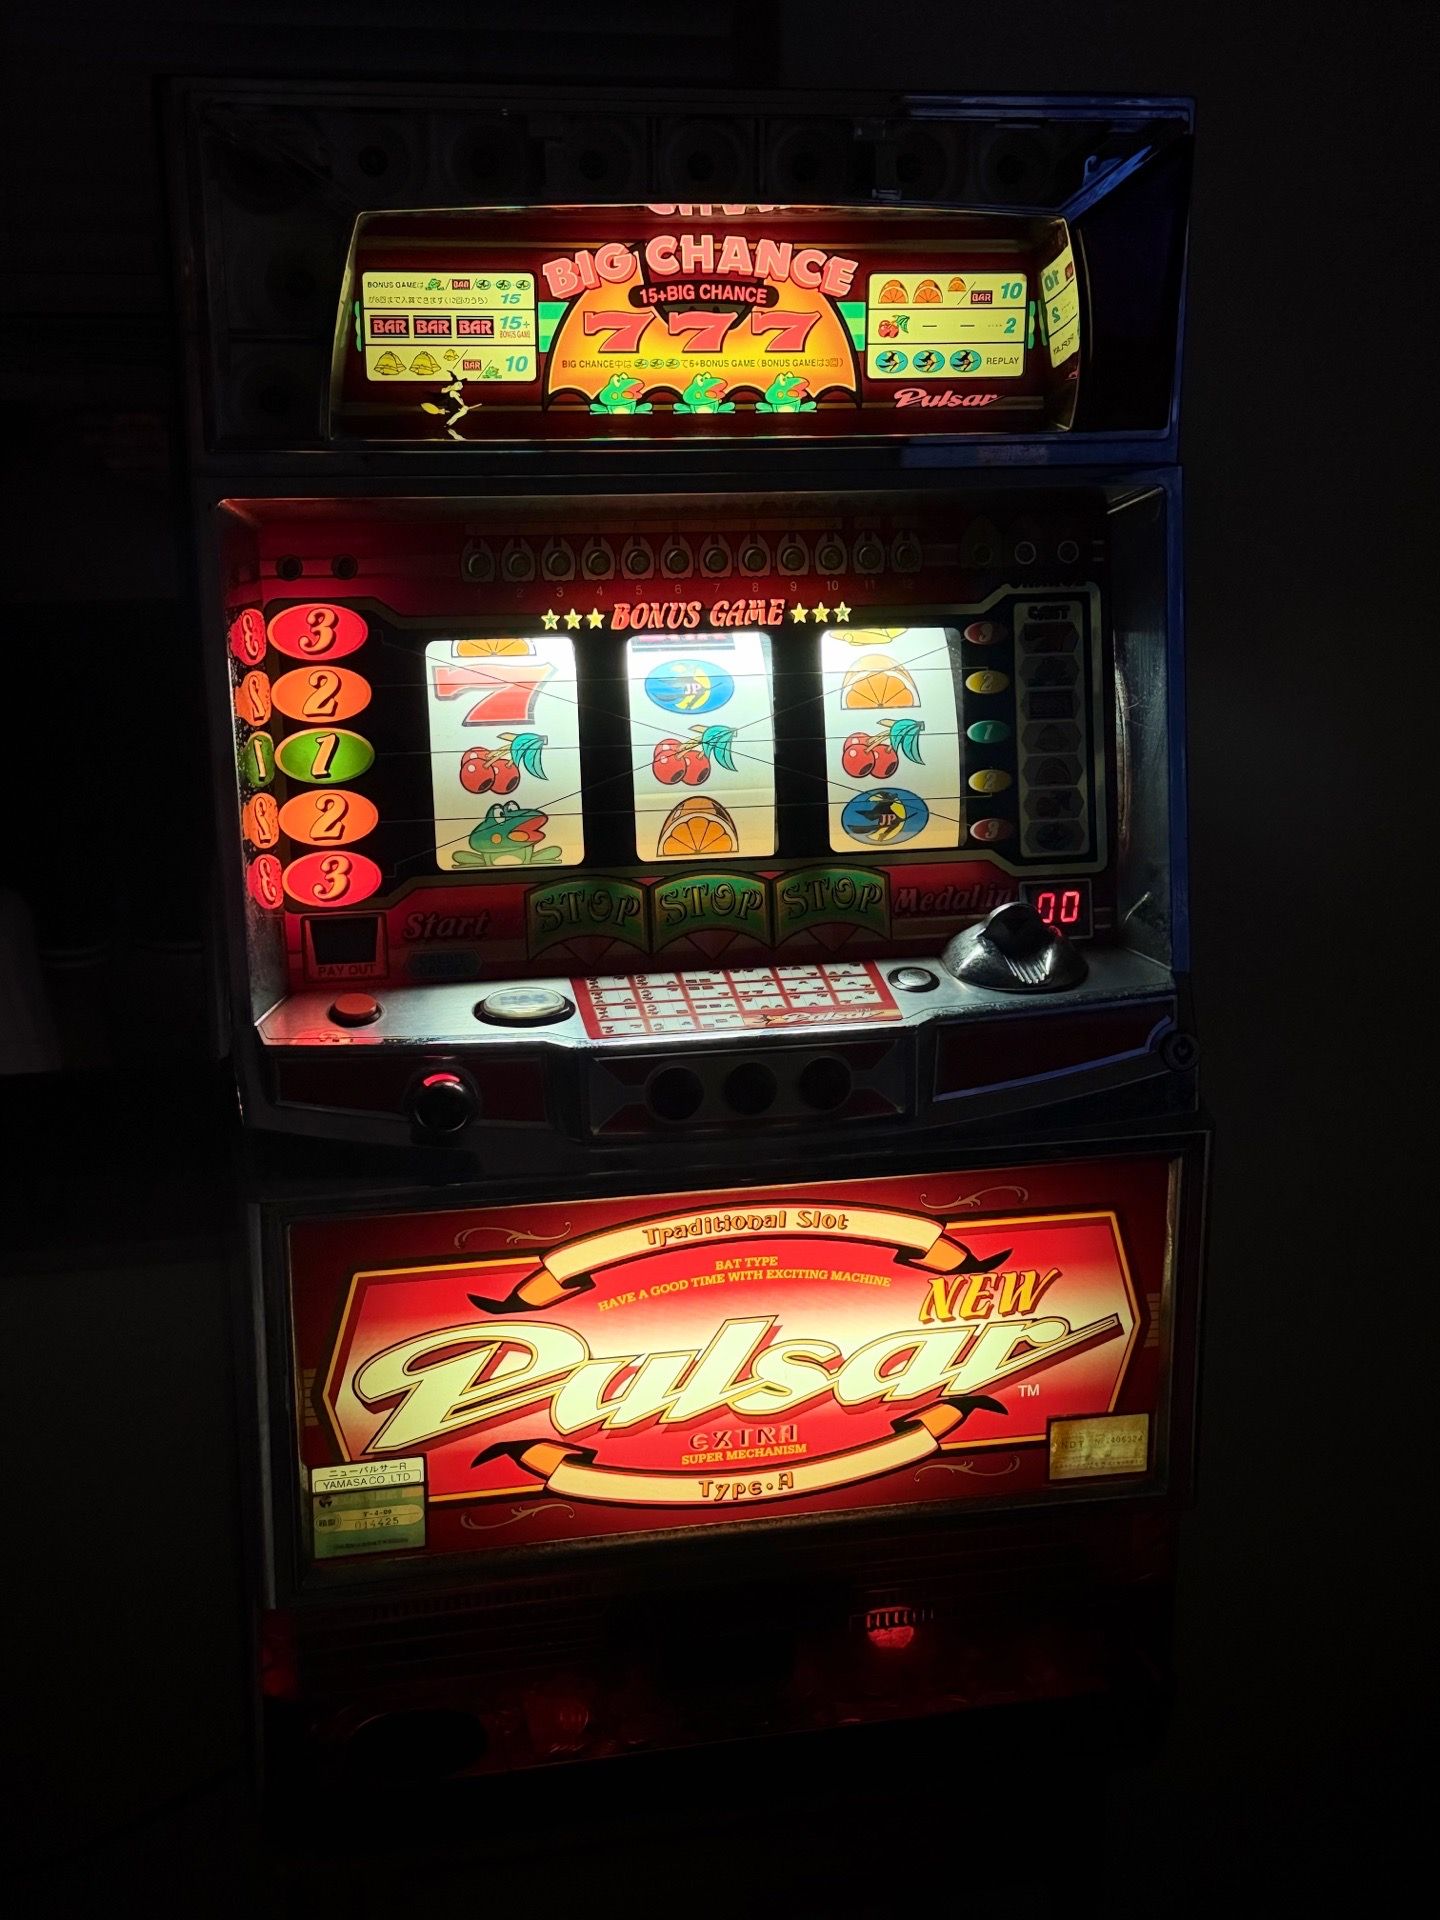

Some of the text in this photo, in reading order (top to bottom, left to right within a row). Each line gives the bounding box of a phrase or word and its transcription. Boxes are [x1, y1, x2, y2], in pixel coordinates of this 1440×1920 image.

[542, 234, 859, 300] BIG CHANCE
[367, 281, 394, 289] BONUS
[639, 283, 768, 304] 15+BIG CHANCE
[1001, 282, 1023, 300] 10
[500, 293, 522, 305] 15
[972, 292, 992, 302] BAR
[373, 319, 408, 334] BAR
[416, 319, 451, 334] BAR
[459, 320, 493, 335] BAR
[583, 310, 656, 354] 7
[668, 310, 739, 354] 7
[751, 310, 822, 354] 7
[1004, 317, 1017, 334] 2
[505, 355, 529, 373] 10
[562, 359, 577, 369] BIG
[986, 356, 1020, 366] REPLAY
[894, 387, 1004, 409] Pulsar
[556, 586, 564, 598] 3
[596, 586, 603, 597] 4
[635, 585, 643, 596] 5
[674, 584, 682, 594] 6
[713, 583, 720, 593] 7
[752, 582, 759, 593] 8
[790, 582, 797, 592] 9
[826, 580, 839, 591] 10
[610, 598, 786, 631] BONUS GAME
[298, 607, 339, 655] 3
[302, 669, 342, 718] 2
[432, 662, 558, 728] 7
[684, 683, 701, 695] JP
[311, 733, 340, 778] 1
[310, 792, 349, 841] 2
[879, 813, 897, 826] JP
[312, 854, 352, 902] 3
[658, 882, 764, 926] STOP
[780, 876, 885, 919] STOP
[894, 884, 988, 913] Medal
[1036, 890, 1081, 925] 00
[535, 889, 641, 932] STOP
[403, 909, 490, 941] Start
[318, 964, 375, 977] PAY OUT
[642, 1209, 849, 1247] Traditional Slot
[715, 1255, 779, 1271] BAT TYPE
[597, 1267, 892, 1312] HAVE A GOOD TIME WITH EXCITING MACHINE
[919, 1267, 1063, 1324] NEW
[351, 1312, 1124, 1456] Pulsar
[1018, 1384, 1040, 1398] TM
[689, 1423, 799, 1452] EXTRA
[681, 1443, 808, 1466] SUPER MECHANISM
